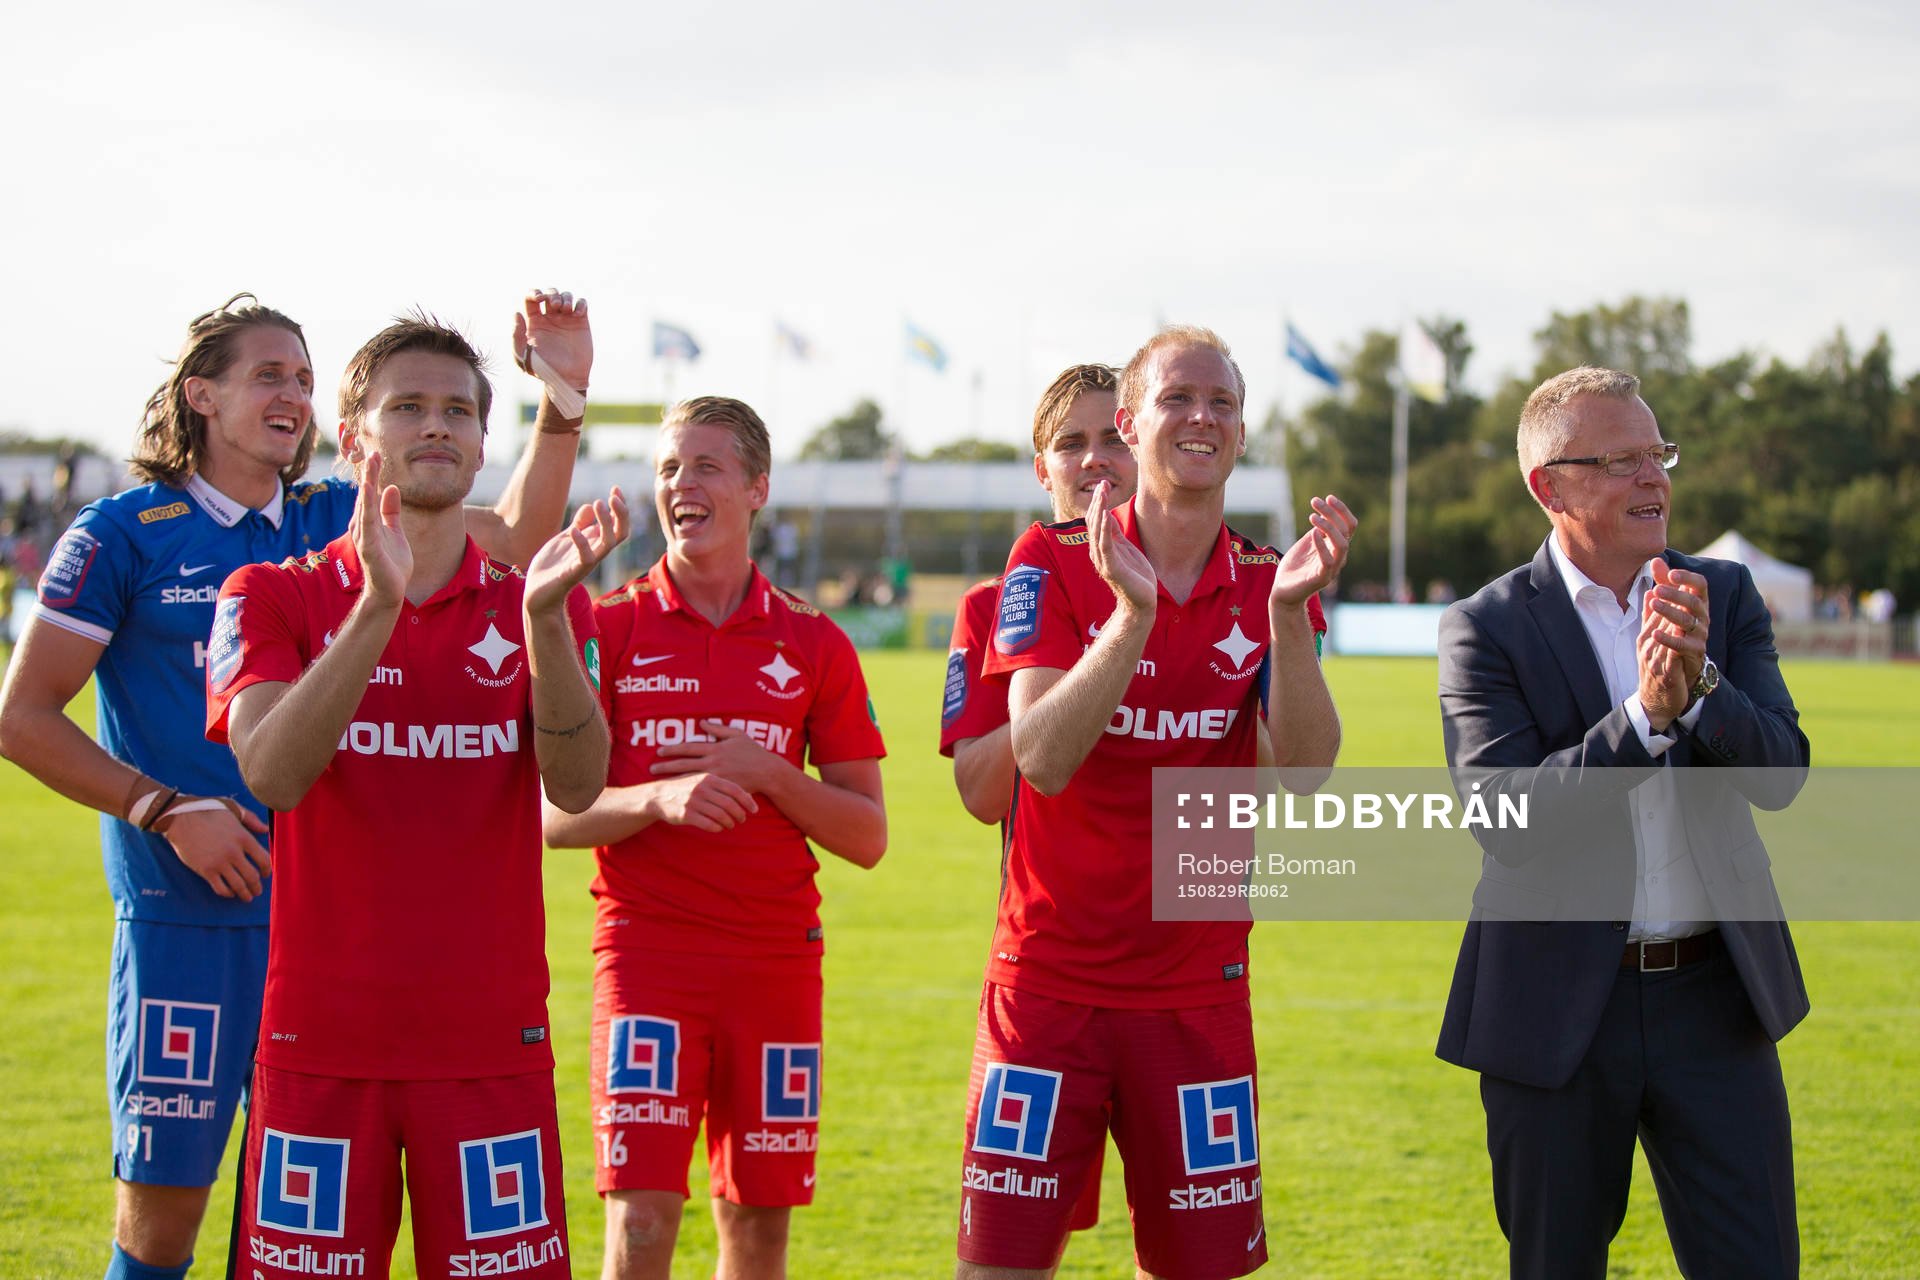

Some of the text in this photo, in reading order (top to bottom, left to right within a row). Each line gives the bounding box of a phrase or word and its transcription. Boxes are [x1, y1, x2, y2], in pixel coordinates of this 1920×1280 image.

[160, 585, 218, 604] stadi
[1003, 591, 1036, 607] SVERIGES
[1009, 582, 1028, 595] HELA
[1001, 600, 1036, 616] FOTBOLLS
[1005, 611, 1028, 624] KLUBB
[464, 661, 523, 688] IFK NORRKÖPING
[1208, 660, 1221, 675] IFK
[614, 674, 700, 694] stadium
[599, 1099, 690, 1128] stadium
[127, 1123, 153, 1162] 91
[600, 1130, 628, 1169] 16
[743, 1128, 819, 1153] stadiu
[962, 1162, 1058, 1199] stadium
[249, 1235, 365, 1276] stadium
[449, 1235, 564, 1277] stadium
